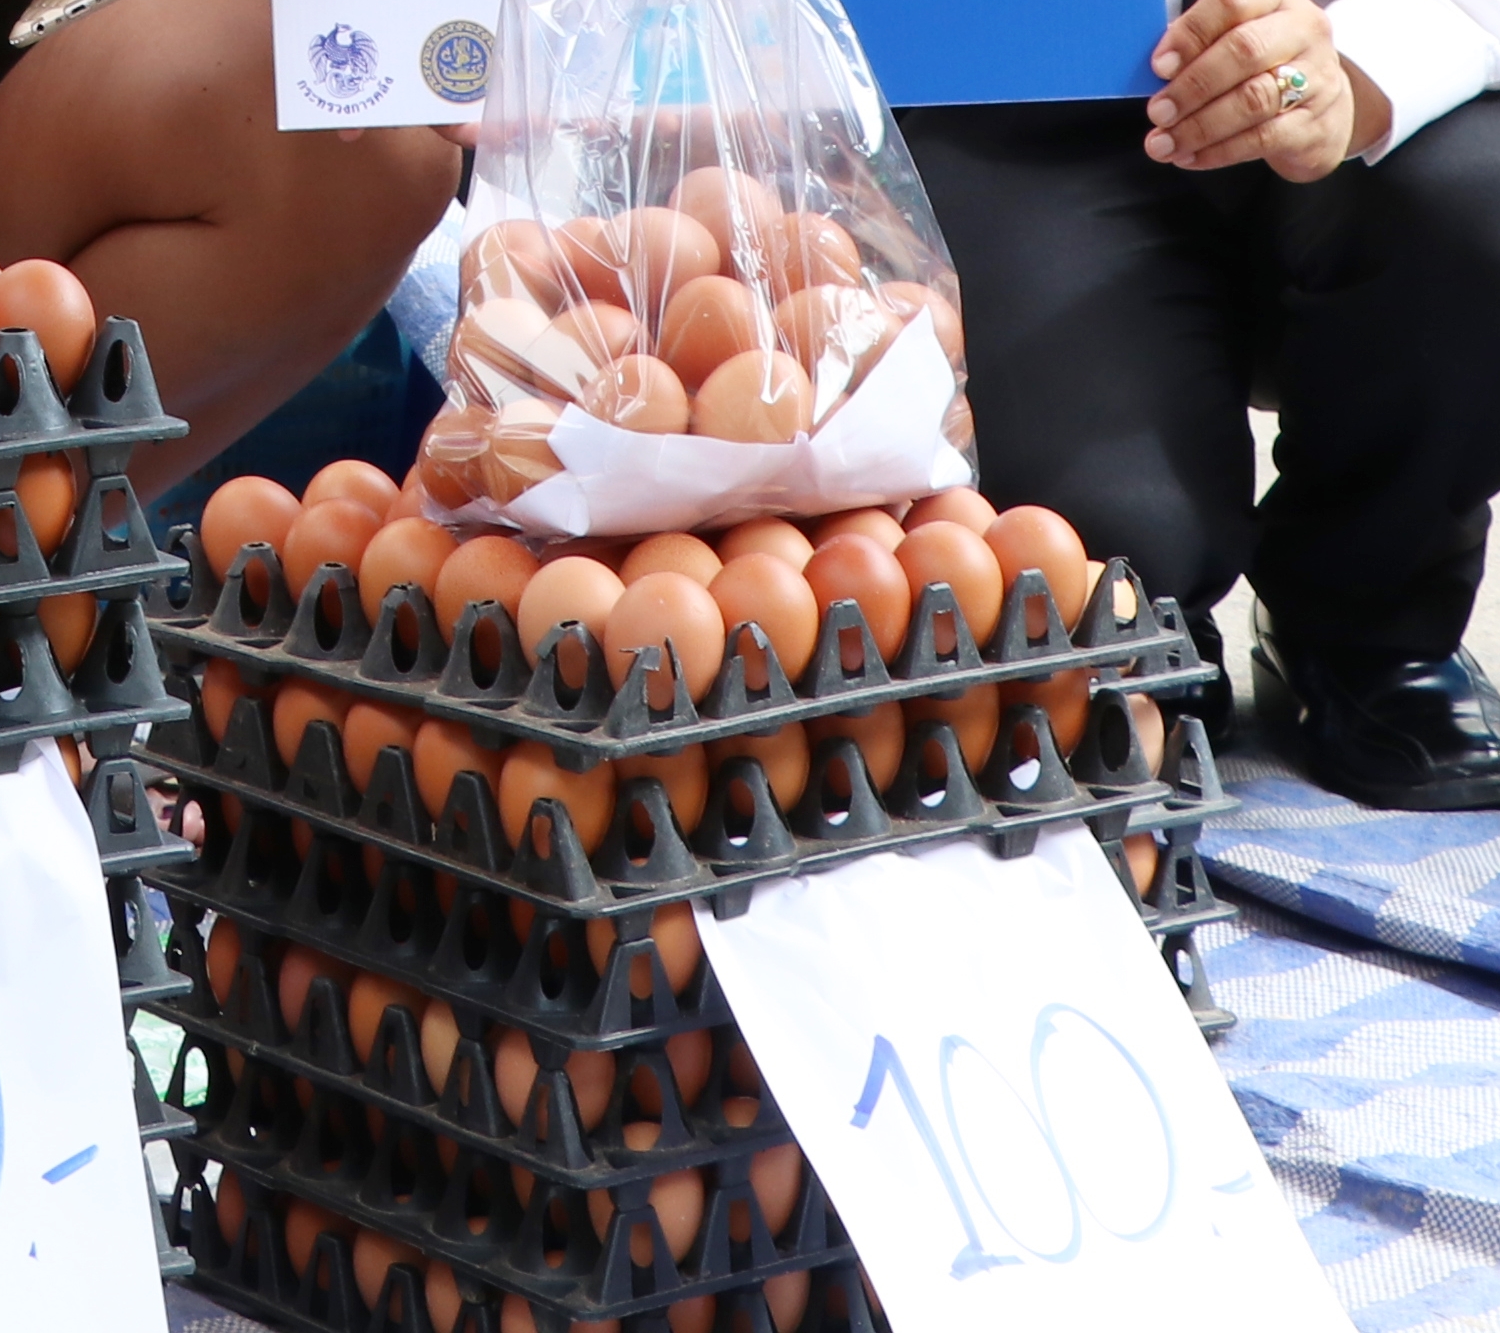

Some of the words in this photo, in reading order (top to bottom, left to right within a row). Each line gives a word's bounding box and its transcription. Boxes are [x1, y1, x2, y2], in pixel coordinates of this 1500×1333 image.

[296, 75, 395, 115] กระทรวงการคลัง
